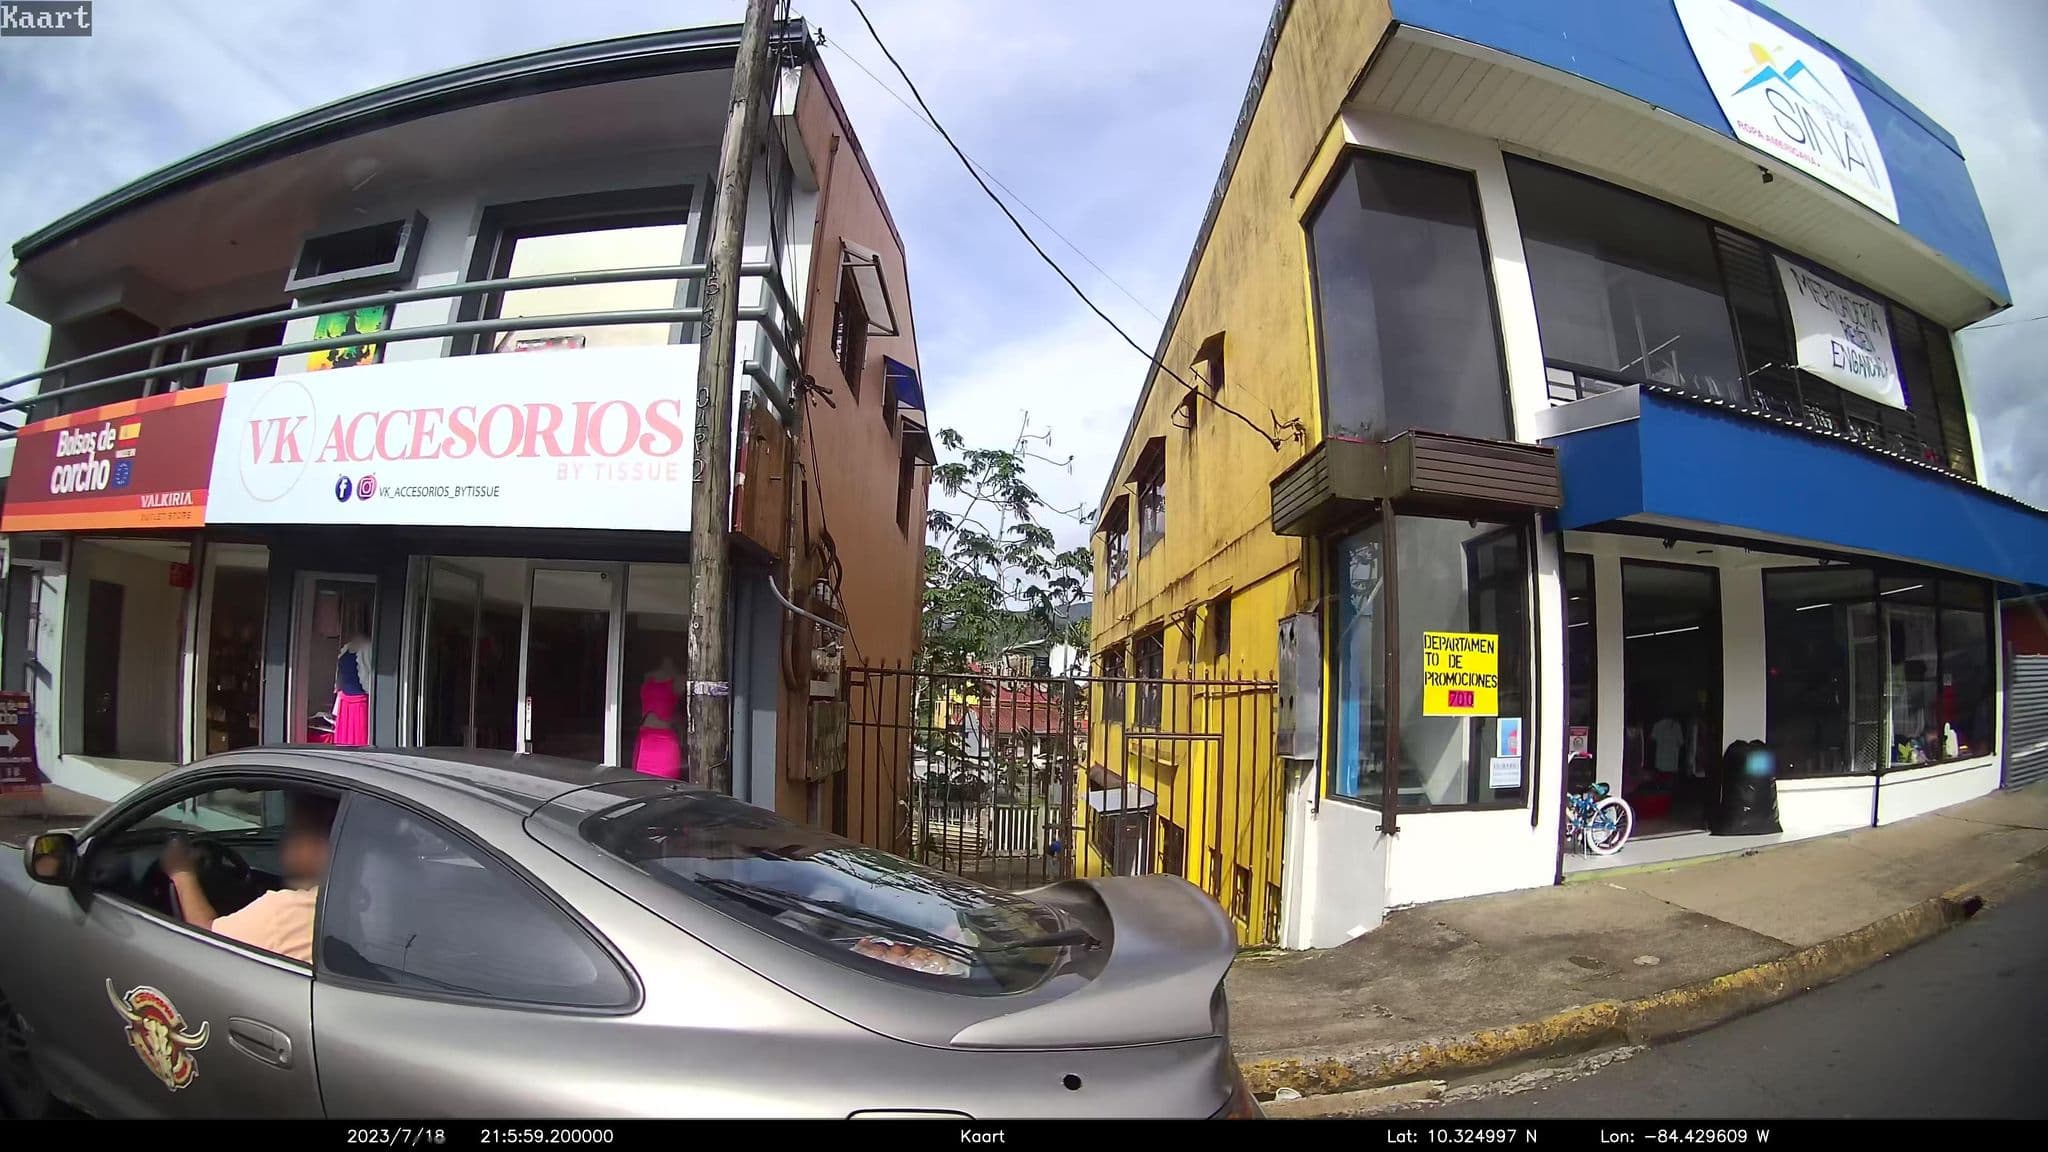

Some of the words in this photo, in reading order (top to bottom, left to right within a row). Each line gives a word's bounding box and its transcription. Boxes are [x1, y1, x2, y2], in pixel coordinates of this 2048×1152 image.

[56, 428, 97, 457] Bolsos
[97, 422, 117, 451] de
[248, 415, 308, 465] VK
[315, 399, 683, 464] ACCESORIOS
[50, 450, 111, 494] corcho
[557, 462, 582, 481] BY
[595, 461, 677, 481] TISSUE
[140, 492, 193, 508] VALKIRIA
[379, 485, 500, 499] VK_ACCESORIOS_BYTISSUE
[1424, 634, 1494, 654] DEPARTAMEN
[1425, 651, 1439, 666] TO
[1448, 654, 1463, 669] DE
[1424, 671, 1498, 688] PROMOCIONES
[1449, 692, 1473, 706] 700
